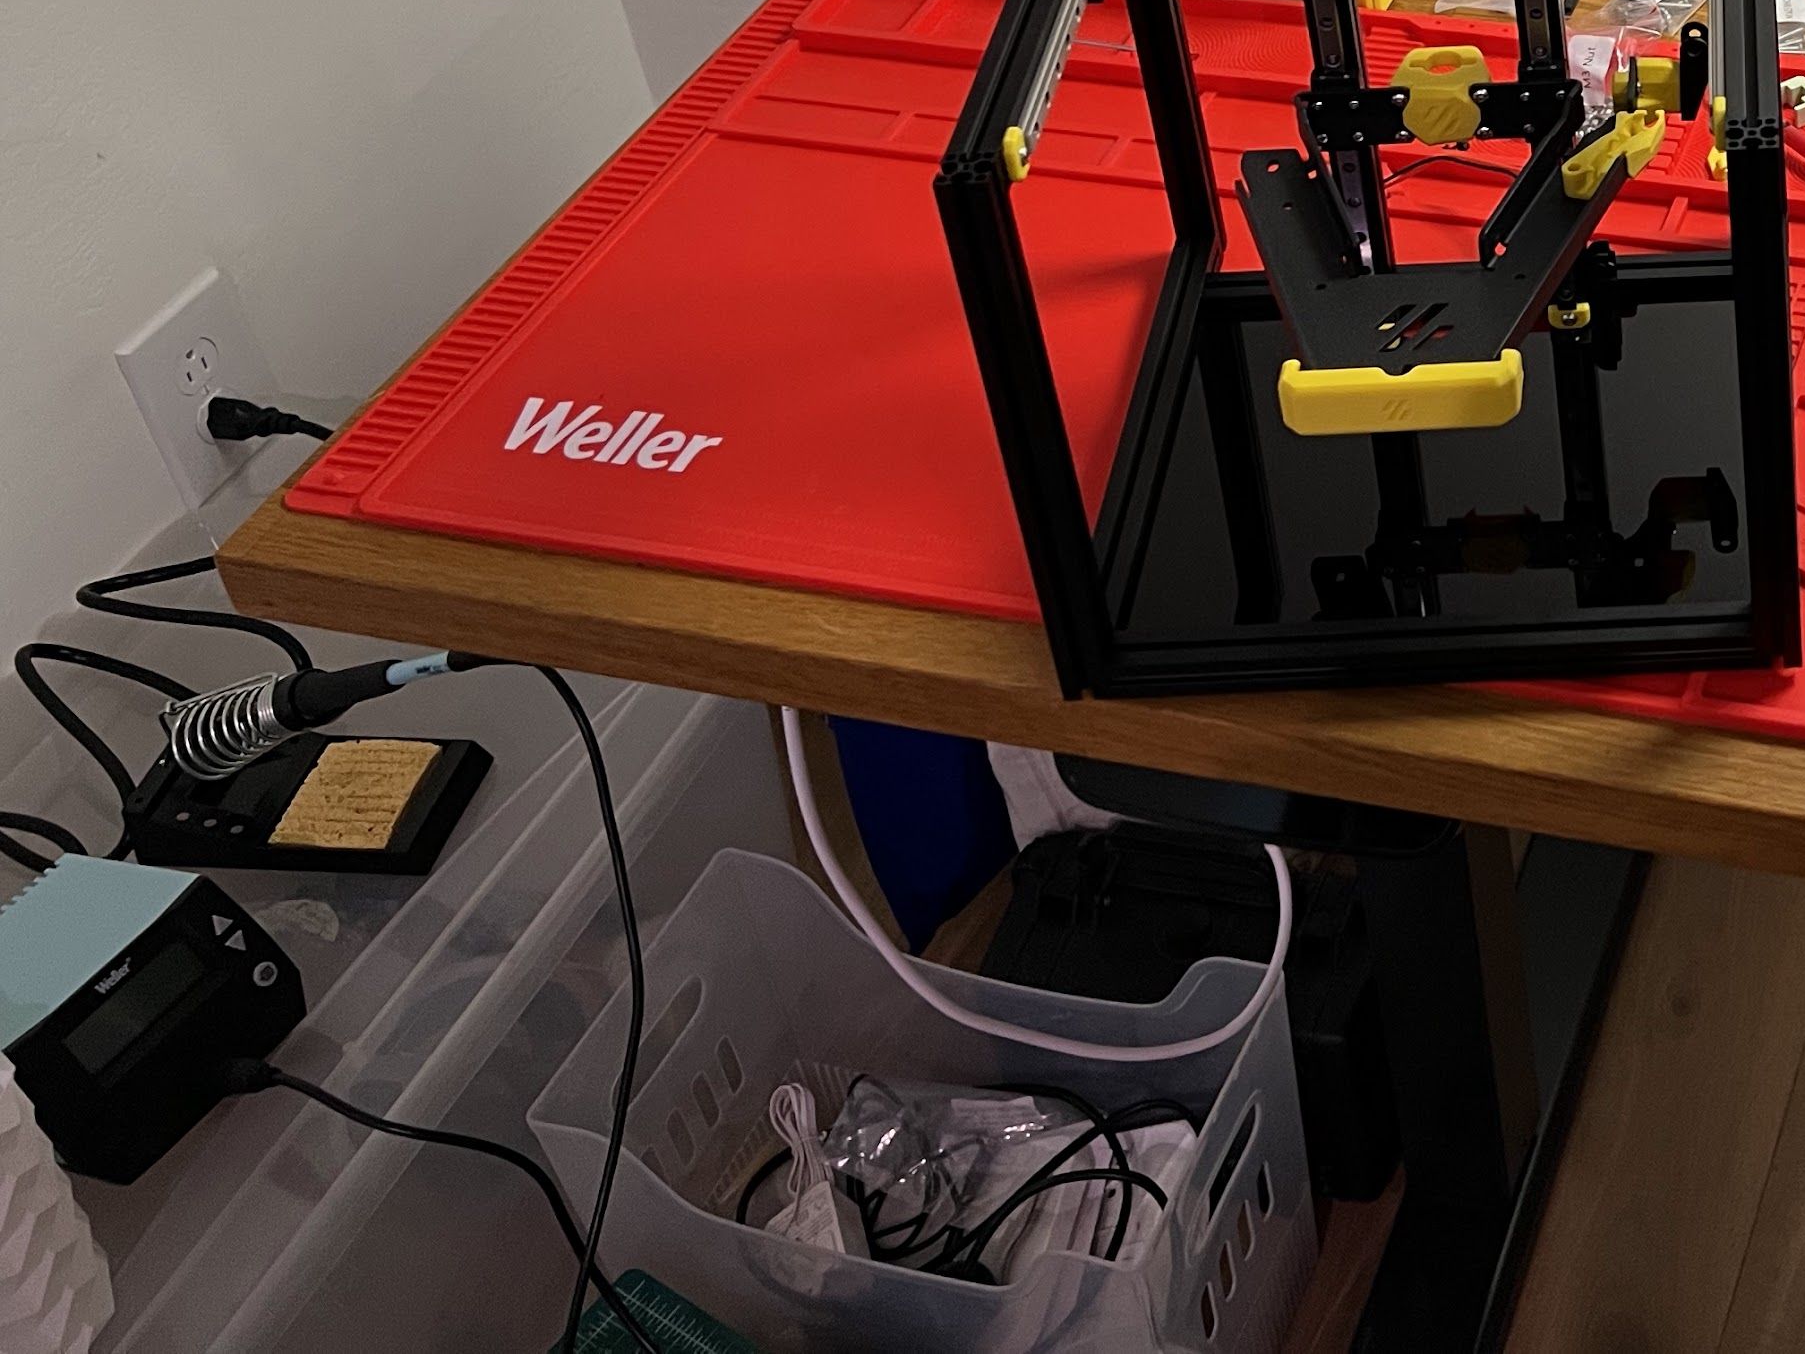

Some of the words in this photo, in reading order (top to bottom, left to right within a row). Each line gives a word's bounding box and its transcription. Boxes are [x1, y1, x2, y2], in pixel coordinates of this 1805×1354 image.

[1583, 47, 1596, 67] Nut
[1582, 71, 1591, 88] M3
[504, 397, 723, 473] Weller
